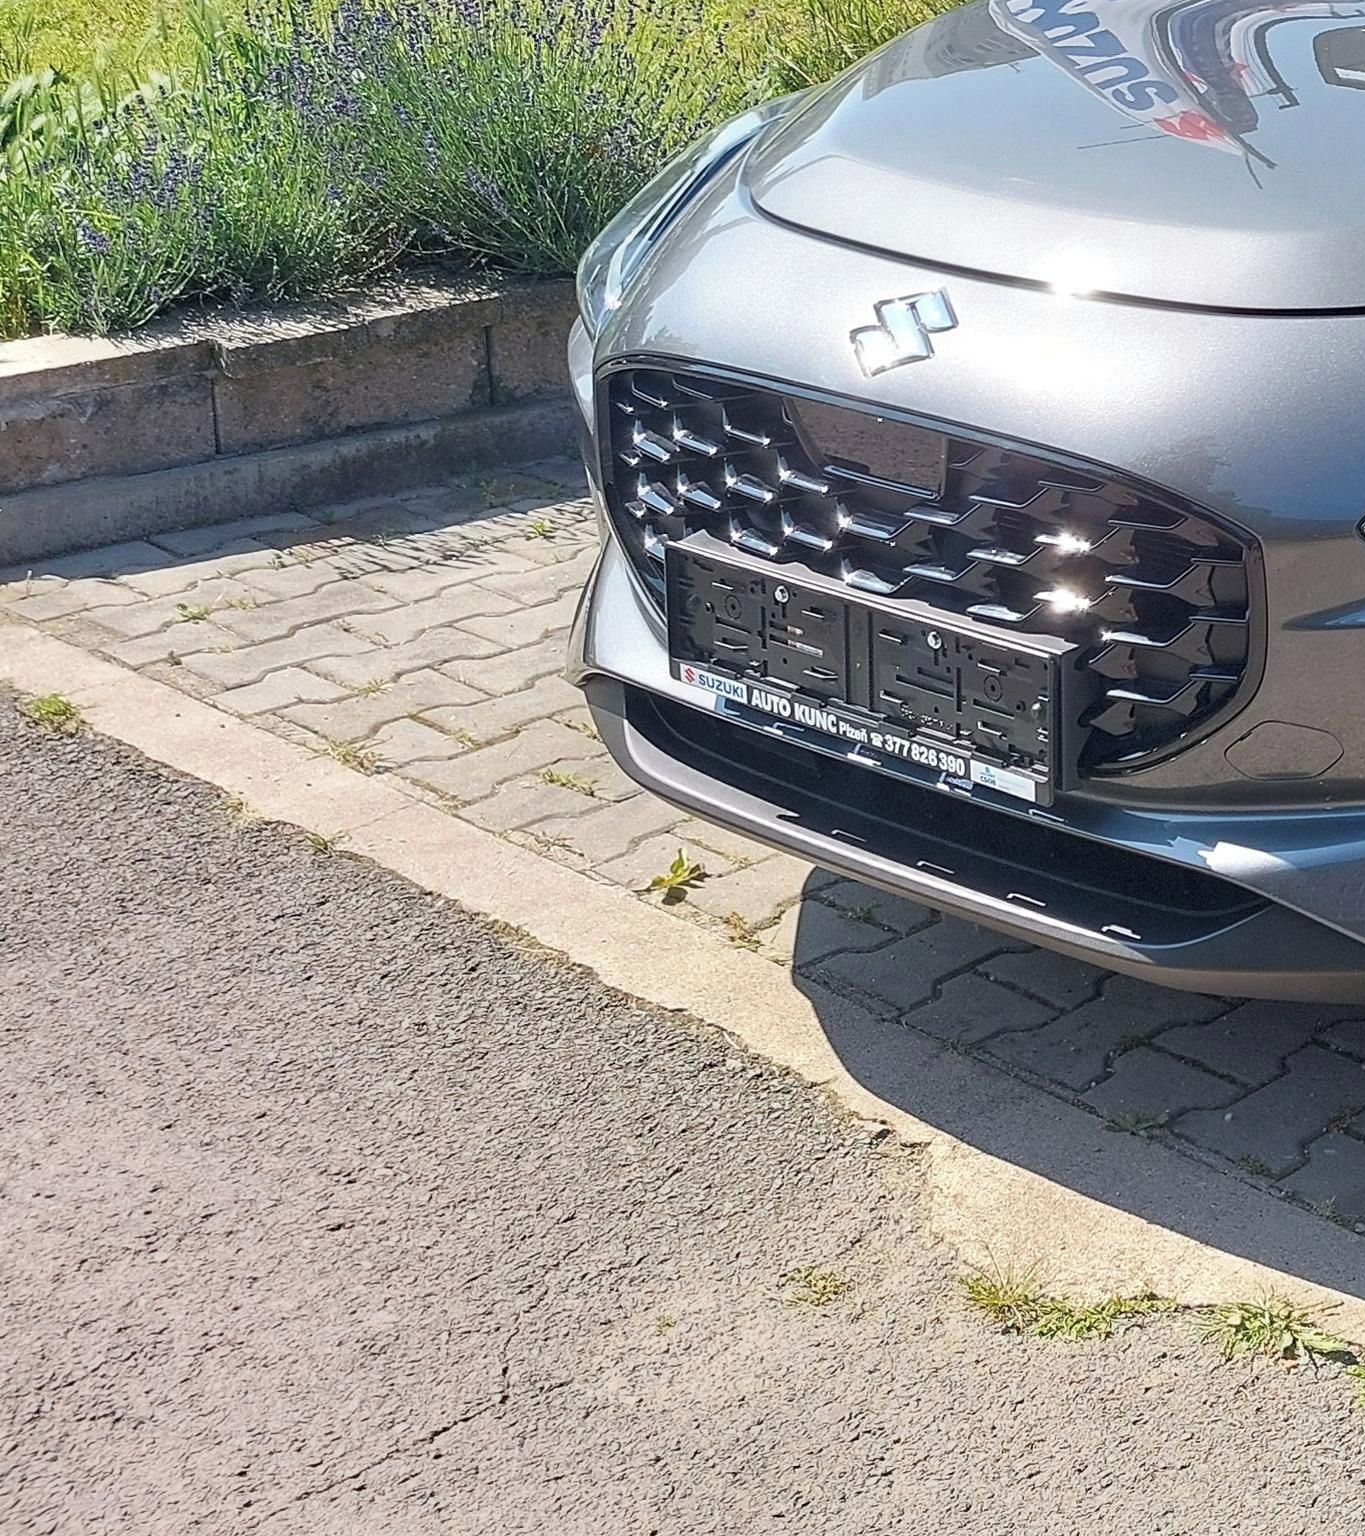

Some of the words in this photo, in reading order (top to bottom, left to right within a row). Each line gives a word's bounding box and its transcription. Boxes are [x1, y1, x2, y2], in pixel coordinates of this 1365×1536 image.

[698, 673, 745, 699] SUZUKI
[750, 688, 792, 718] AUTO
[793, 701, 838, 732] KUNC
[838, 720, 869, 744] Plzeň
[884, 732, 910, 757] 377
[910, 742, 939, 767] 826
[938, 751, 966, 777] 390
